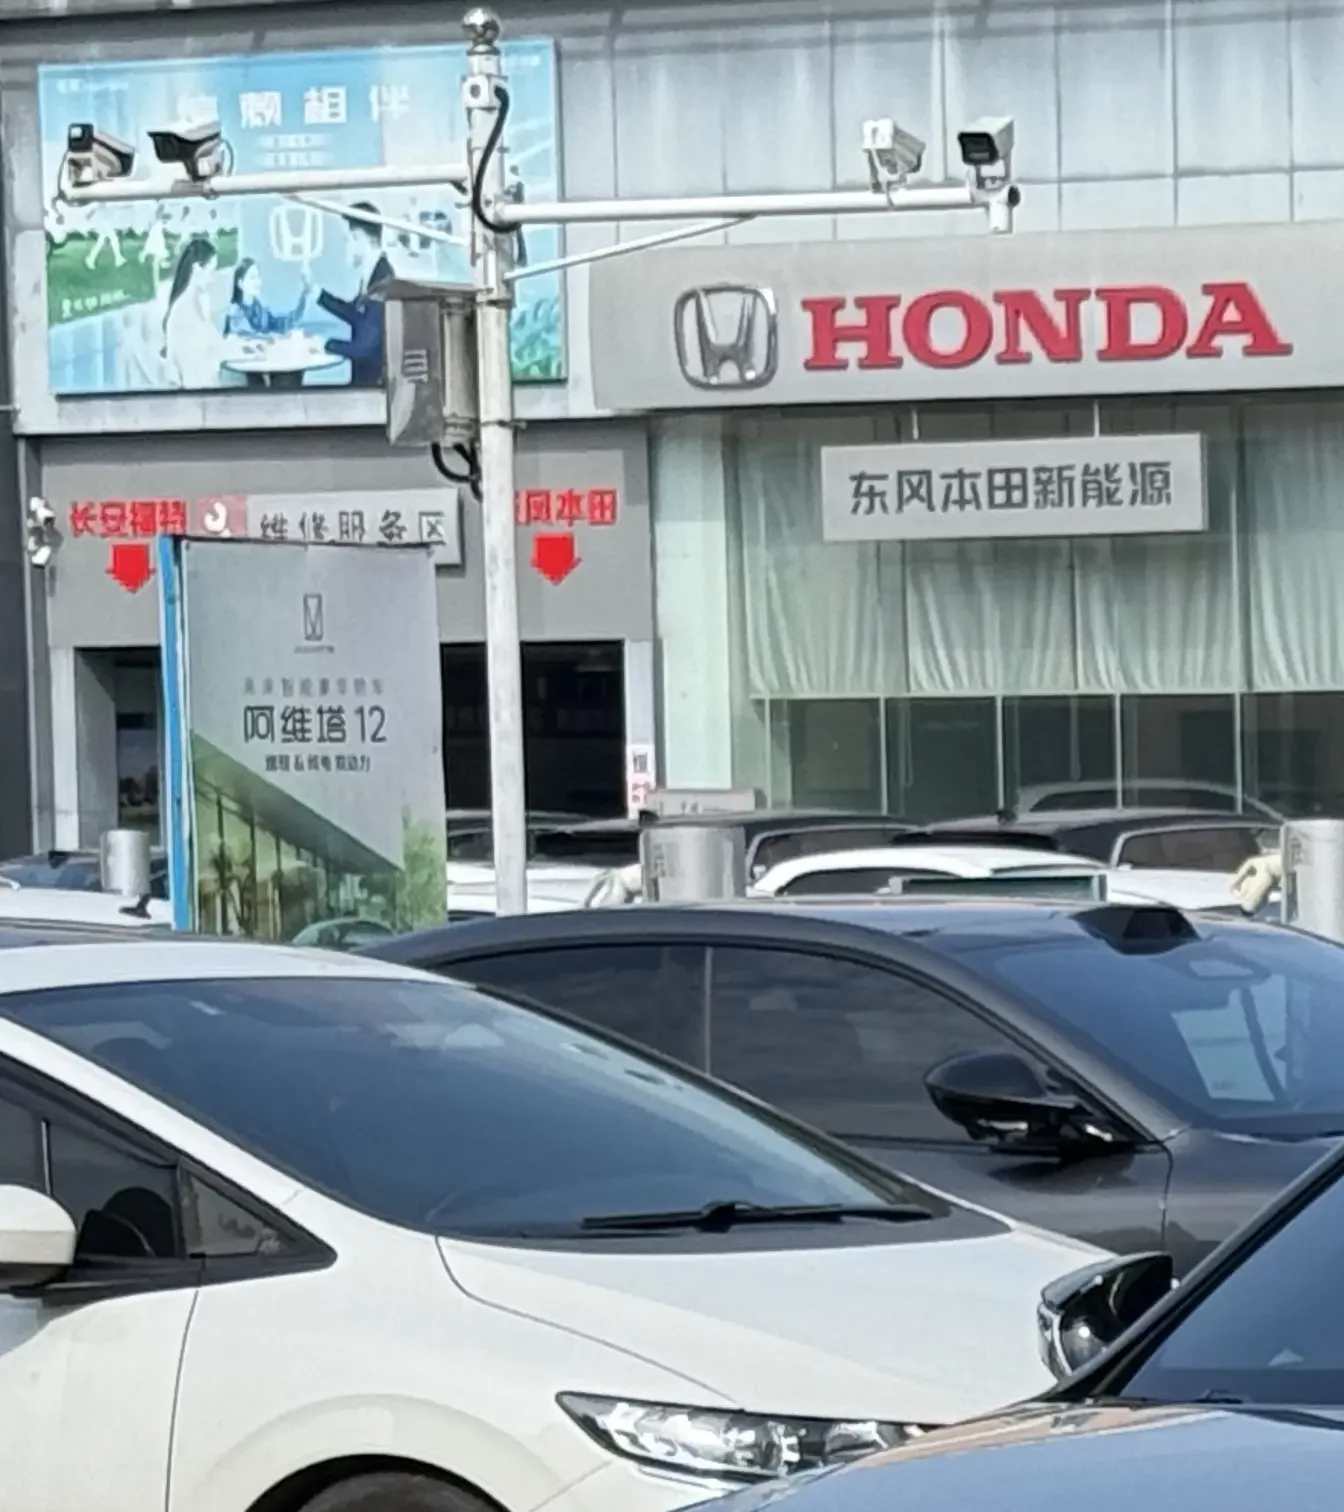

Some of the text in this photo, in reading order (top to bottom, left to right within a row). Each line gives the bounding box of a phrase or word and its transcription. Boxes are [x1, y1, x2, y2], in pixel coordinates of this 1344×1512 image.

[801, 281, 1293, 371] HONDA
[514, 488, 618, 528] 风本田
[848, 460, 1173, 515] 东风本田新能源
